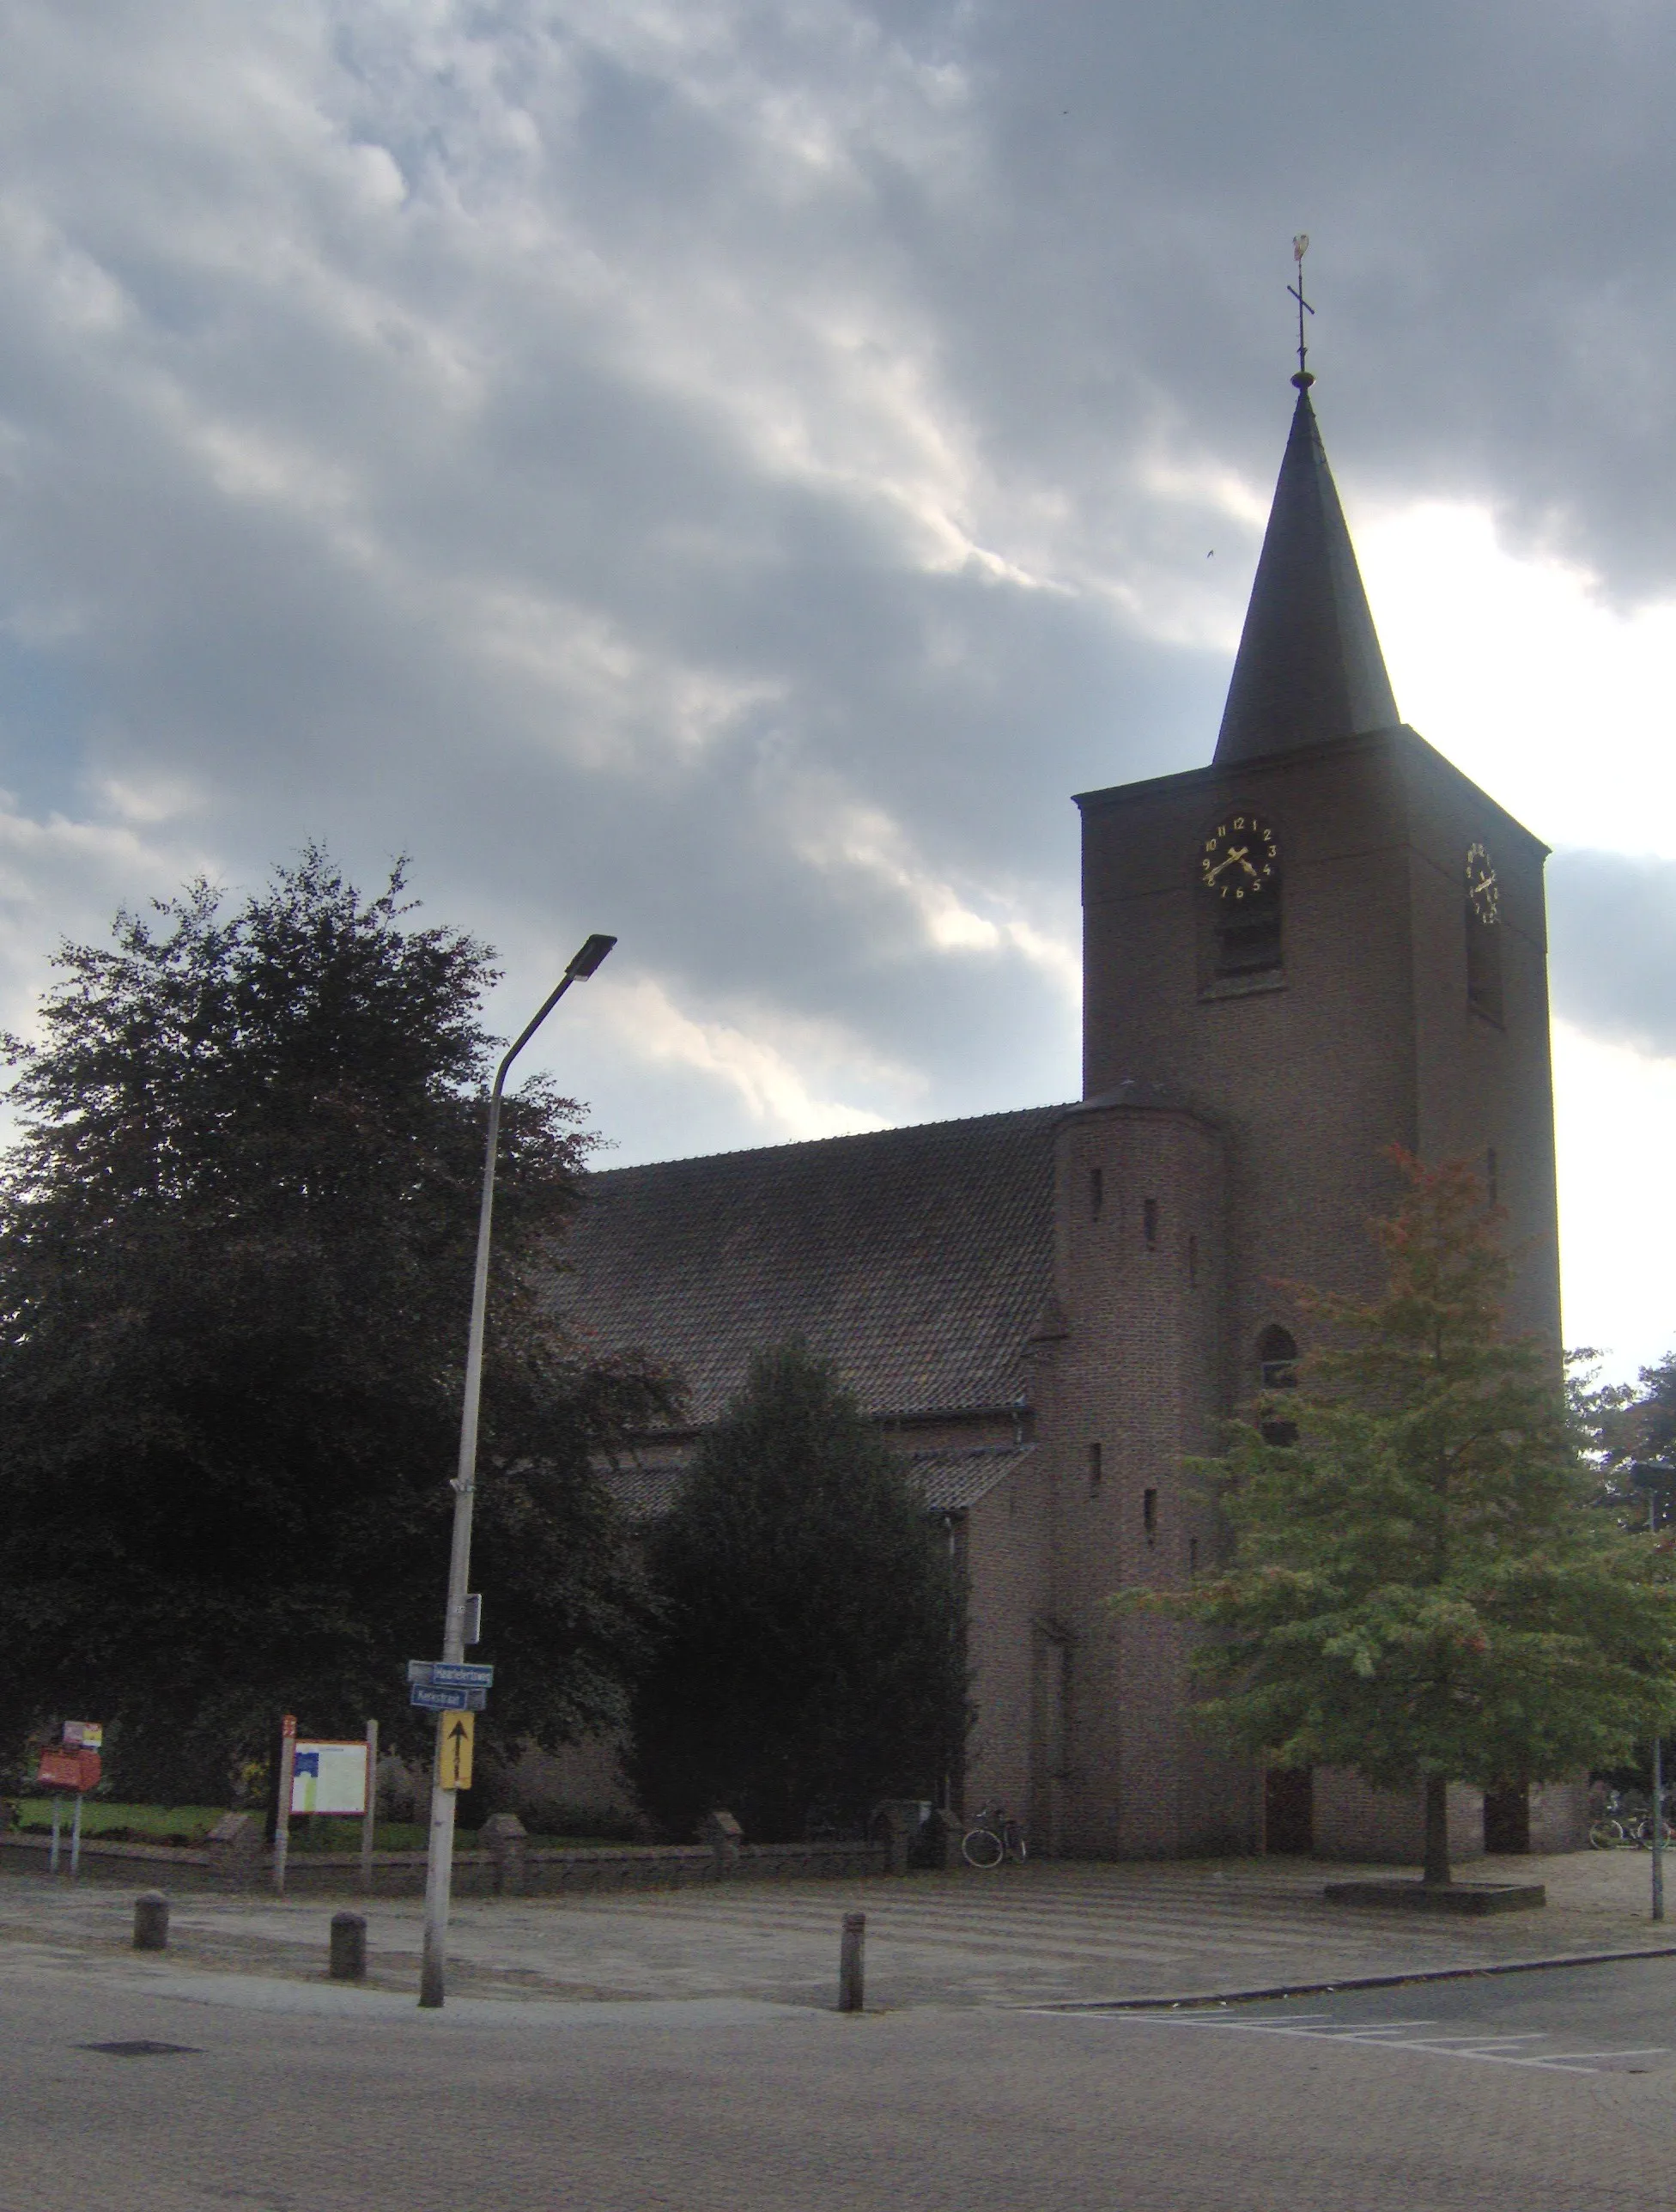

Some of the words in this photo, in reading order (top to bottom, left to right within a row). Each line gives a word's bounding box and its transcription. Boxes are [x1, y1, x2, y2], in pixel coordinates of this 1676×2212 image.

[1233, 817, 1244, 830] 12
[1253, 819, 1257, 831] 1
[1218, 825, 1225, 836] 11
[1264, 829, 1271, 841] 2
[1206, 838, 1216, 852] 10
[1268, 845, 1277, 857] 3
[1203, 859, 1210, 870] 9
[1263, 864, 1271, 876] 4
[1254, 878, 1260, 891] 5
[1221, 885, 1228, 897] 7
[1236, 886, 1243, 899] 6
